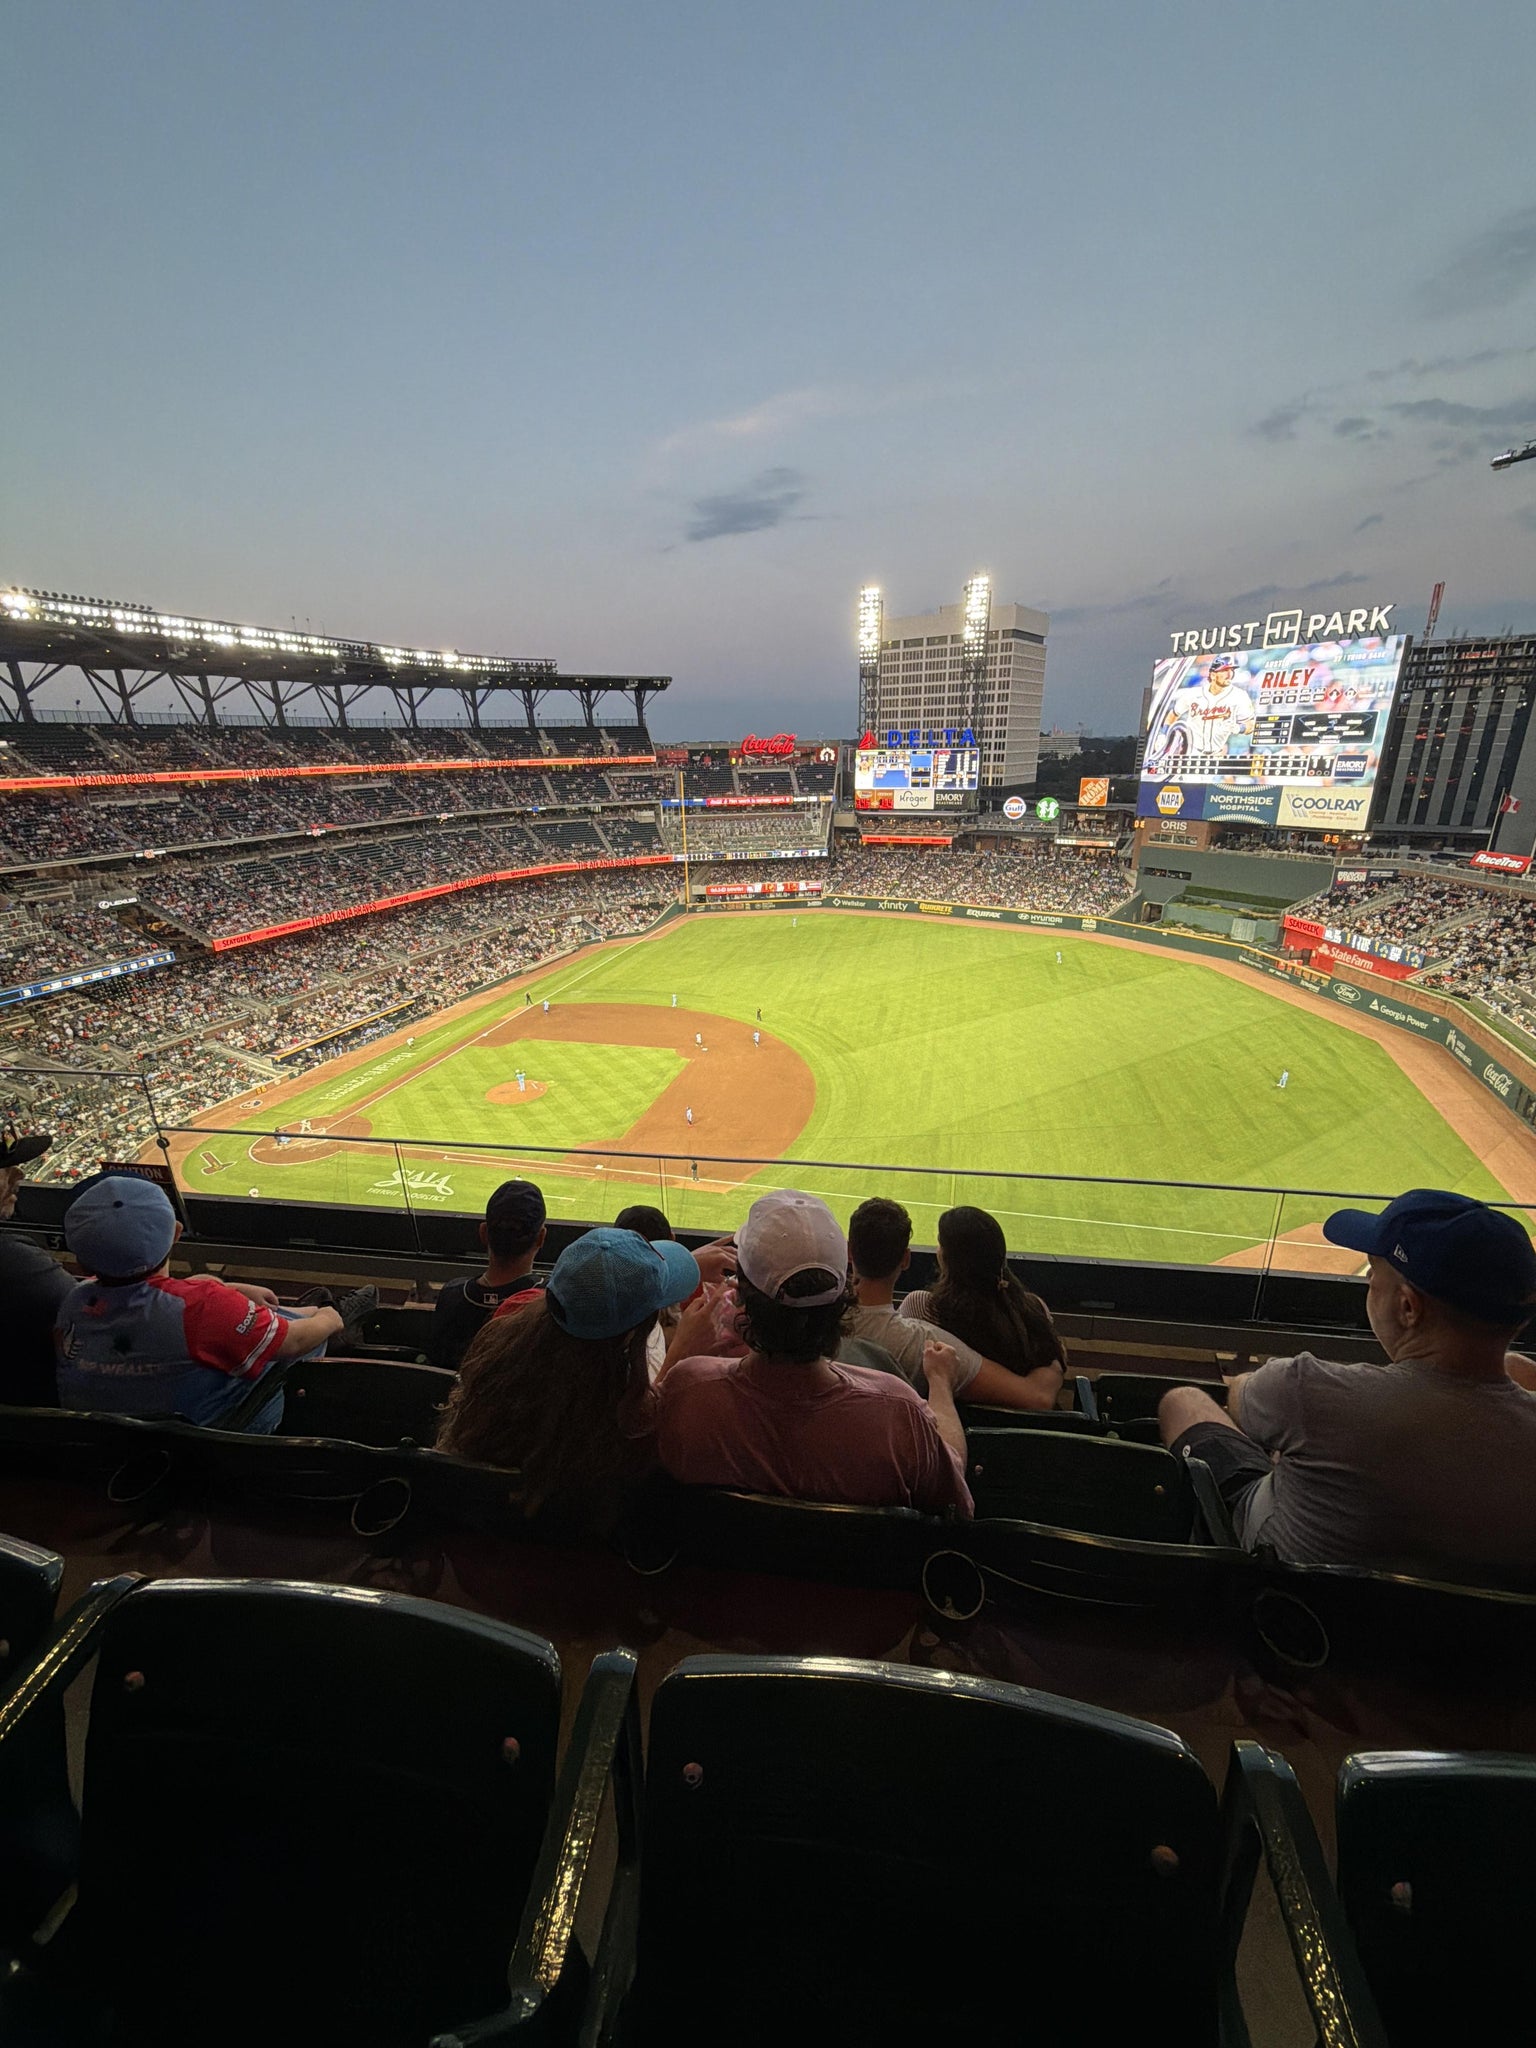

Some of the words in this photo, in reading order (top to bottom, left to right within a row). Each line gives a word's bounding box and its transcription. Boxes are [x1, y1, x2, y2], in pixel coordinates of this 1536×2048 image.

[1170, 622, 1259, 652] TRUIST
[1307, 604, 1393, 638] PARK
[1261, 668, 1315, 689] RILEY
[741, 733, 797, 755] Coca-Cola
[887, 728, 976, 748] DELTA
[74, 776, 89, 787] THE
[89, 774, 126, 786] ATLANTA
[126, 773, 156, 785] BRAVES
[900, 791, 928, 807] Kroger
[936, 794, 964, 802] EMORY
[1080, 779, 1108, 805] HOME
[1160, 793, 1179, 807] NAPA
[1210, 795, 1275, 806] NORTHSIDE
[1292, 797, 1365, 811] COOLRAY
[1161, 820, 1187, 831] ORIS
[1475, 853, 1523, 869] RaceTrac
[842, 899, 866, 907] Wellstar
[878, 900, 908, 911] xfinity
[919, 903, 953, 913] QUIKRETE
[966, 909, 1001, 918] EQUIFAX
[1031, 915, 1063, 923] HYUNDAI
[1288, 918, 1320, 936] SEATGEEK
[222, 934, 252, 948] SEATGEEK
[1337, 985, 1356, 999] Ford
[1380, 1005, 1406, 1022] Georgia
[1406, 1015, 1429, 1030] Power
[1483, 1063, 1513, 1097] Coca-Cola
